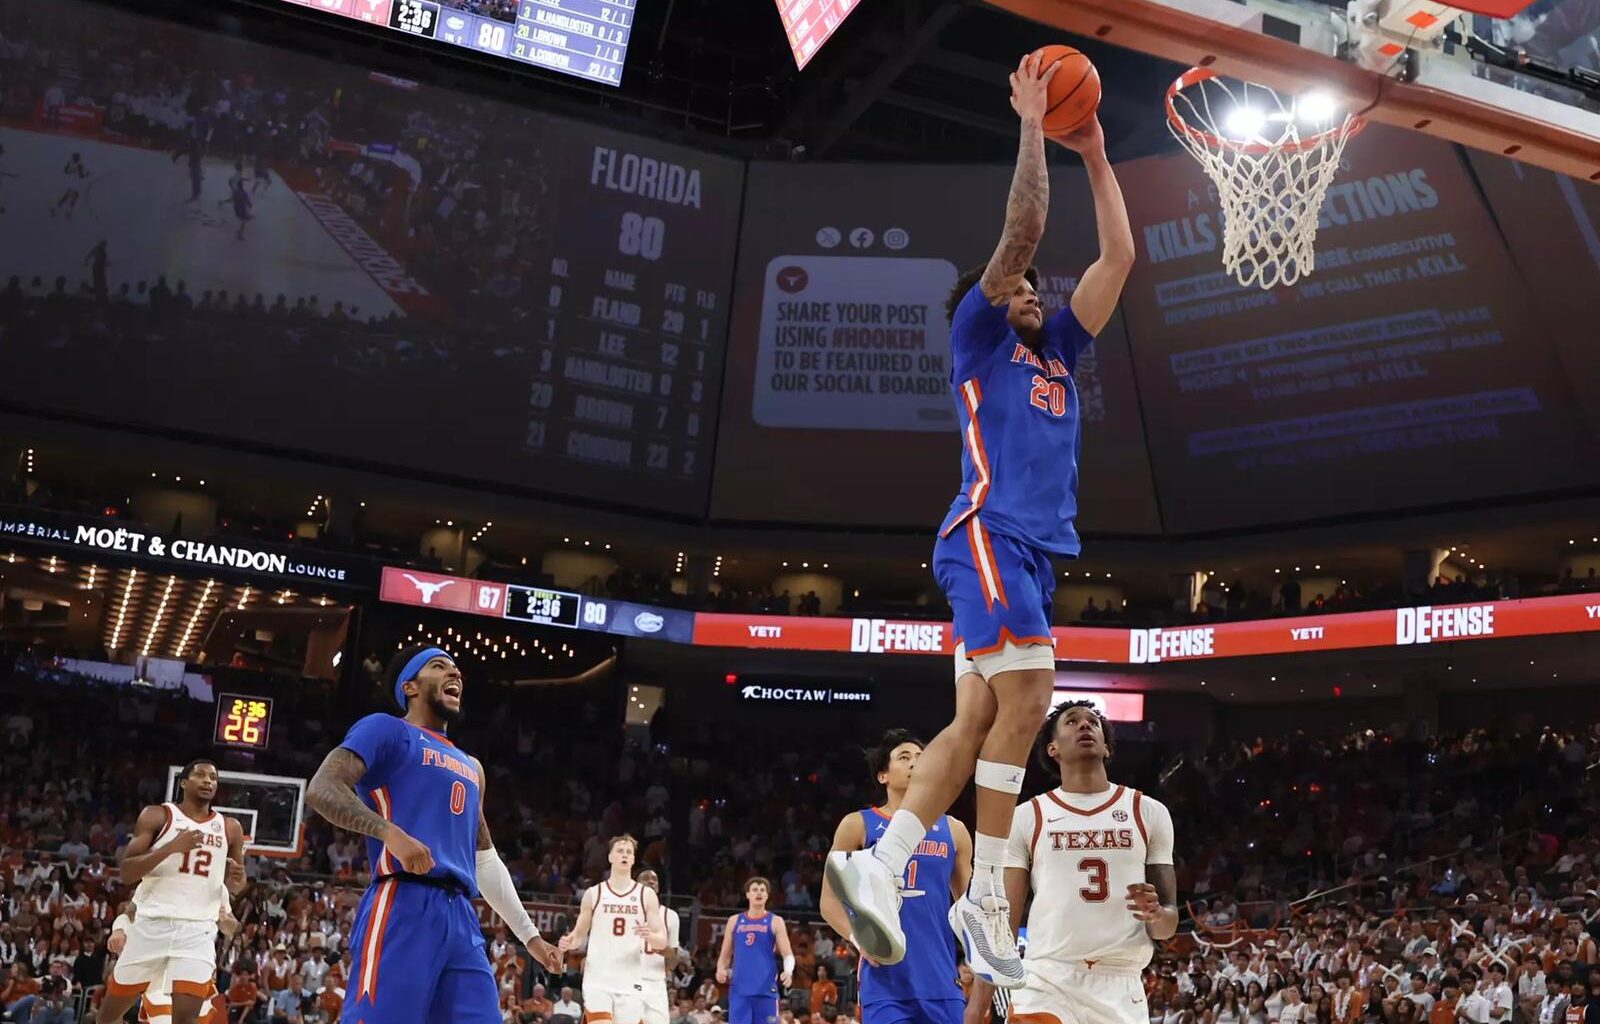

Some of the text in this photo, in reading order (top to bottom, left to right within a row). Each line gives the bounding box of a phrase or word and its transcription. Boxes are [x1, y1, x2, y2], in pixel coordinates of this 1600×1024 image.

[398, 4, 431, 28] 2:36
[478, 23, 505, 51] 80
[517, 24, 530, 37] 20
[515, 43, 525, 56] 21
[591, 146, 701, 209] FLORIDA
[618, 212, 665, 261] 80
[1143, 213, 1218, 264] KILLS
[1326, 275, 1363, 295] CALL
[1363, 267, 1402, 289] THAT
[1418, 252, 1468, 278] KILL
[775, 302, 928, 325] SHARE YOUR POST
[774, 326, 927, 351] USING #HOOKEM
[773, 351, 945, 373] TO BE FEATURED ON
[770, 373, 949, 396] OUR SOCIAL BOARD!
[1030, 374, 1066, 417] 20
[526, 420, 546, 449] 21
[74, 525, 145, 552] MOËT
[148, 536, 165, 556] &
[170, 540, 287, 573] CHANDON
[288, 562, 346, 580] LOUNGE
[478, 586, 501, 610] 67
[526, 596, 562, 618] 2:36
[583, 601, 607, 625] 80
[1396, 605, 1495, 645] DEFENSE
[748, 625, 783, 639] YETI
[851, 618, 944, 653] DEFENSE
[1290, 626, 1325, 641] YETI
[1129, 627, 1215, 664] DEFENSE
[742, 685, 871, 701] CHOCTAW RESORTS
[232, 699, 266, 718] 2:36
[224, 714, 259, 743] 26
[450, 780, 466, 815] 0
[1047, 828, 1134, 851] TEXAS
[178, 849, 213, 877] 12
[907, 860, 918, 889] 1
[1077, 856, 1110, 903] 3
[602, 904, 638, 915] TEXAS
[612, 917, 626, 937] 8
[744, 932, 756, 946] 3
